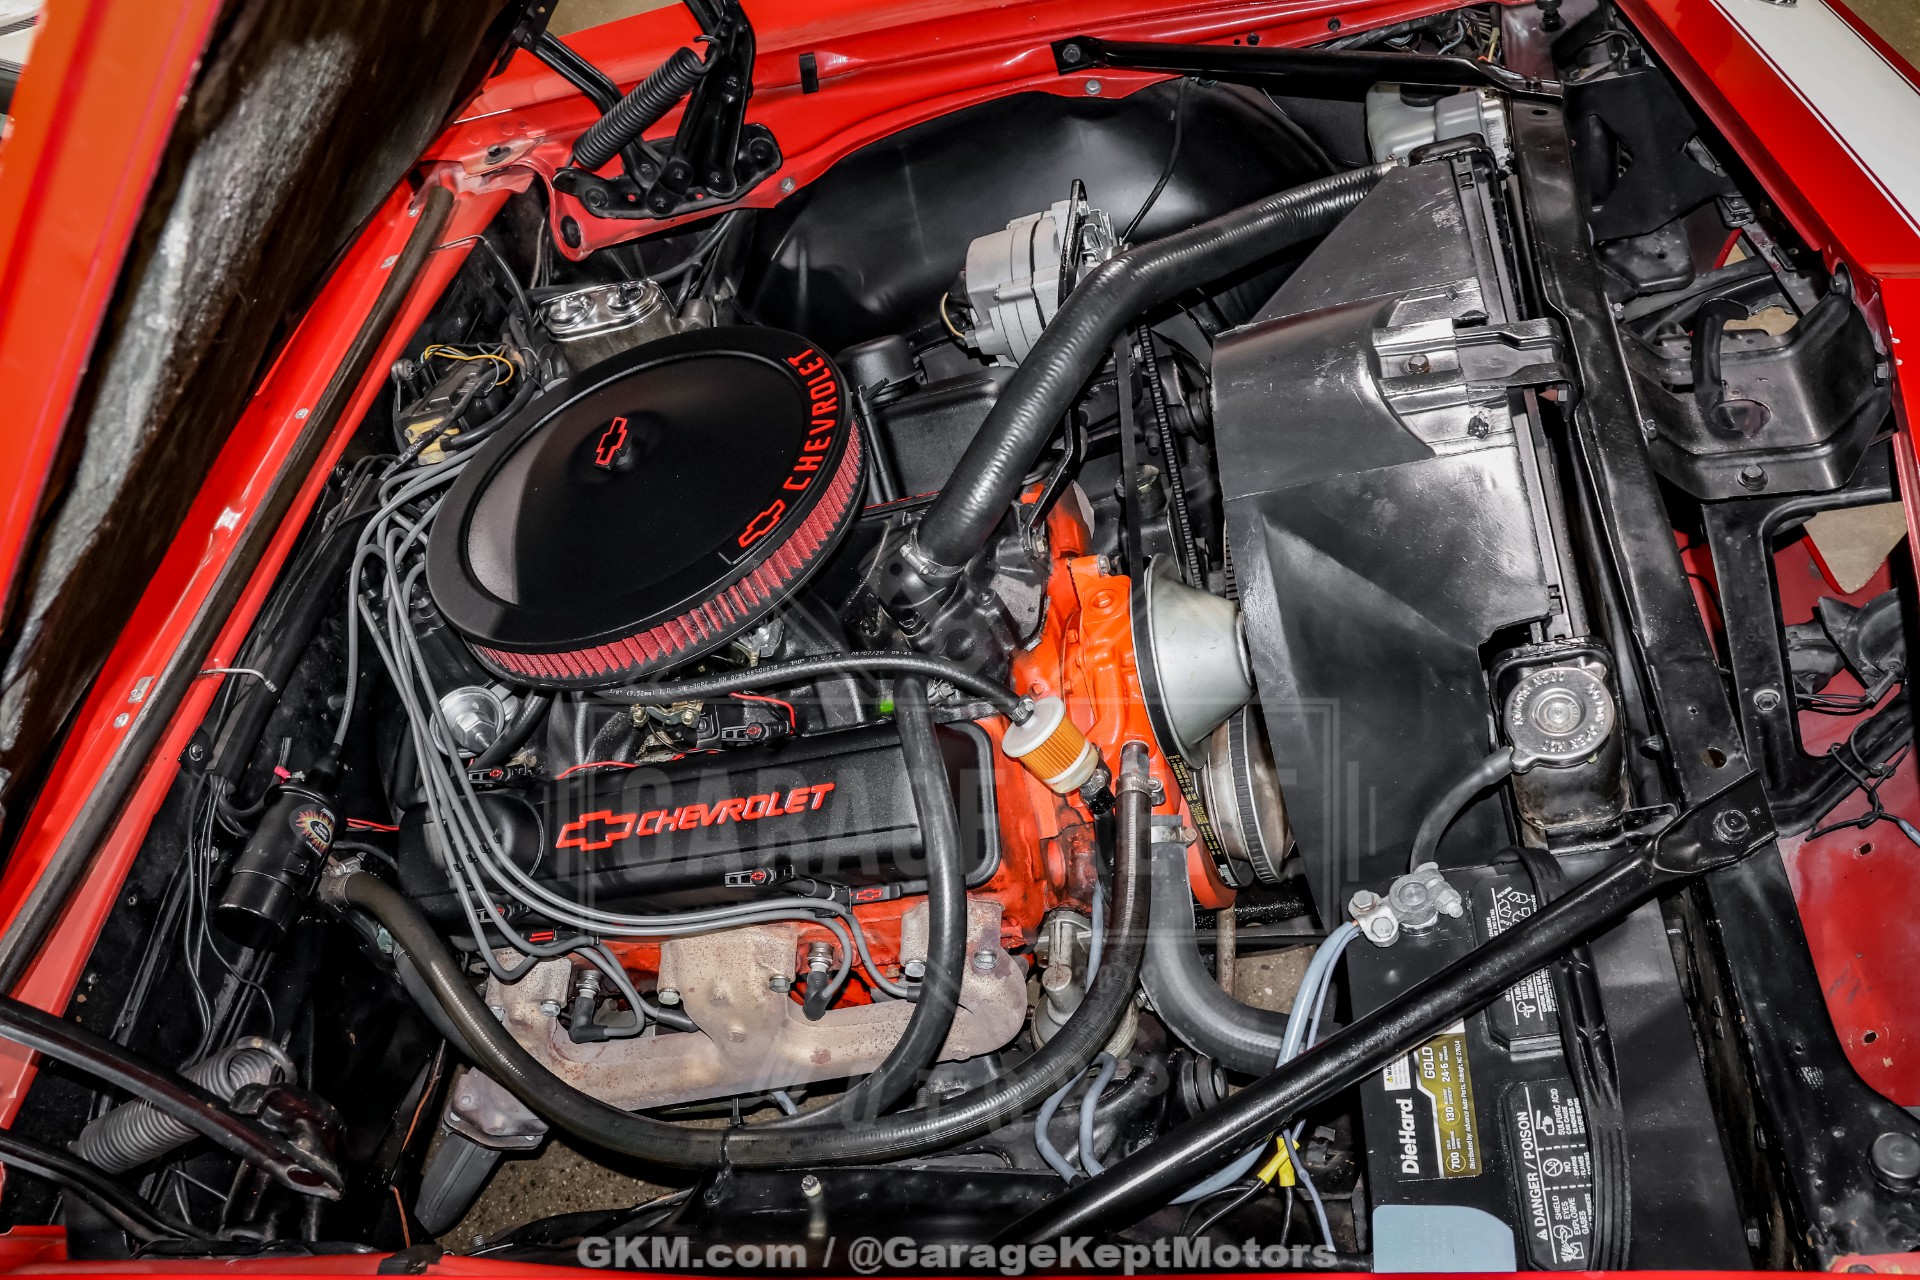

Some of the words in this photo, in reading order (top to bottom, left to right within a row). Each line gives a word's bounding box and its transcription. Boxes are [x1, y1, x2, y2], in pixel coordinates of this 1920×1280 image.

[783, 348, 838, 491] CHEVROLET
[636, 782, 835, 836] CHEVROLET
[1421, 1046, 1436, 1079] GOLD
[1461, 1098, 1469, 1111] Auto
[1550, 1088, 1560, 1103] ACID
[1445, 1106, 1455, 1122] 130
[1463, 1110, 1471, 1132] Advance
[1553, 1104, 1566, 1136] SULFURIC
[1561, 1105, 1571, 1123] CAUSE
[1396, 1098, 1420, 1175] DieHard
[1516, 1110, 1536, 1161] POISON
[1565, 1122, 1573, 1136] CAN
[1450, 1151, 1461, 1170] 700
[1466, 1140, 1477, 1170] Distributed
[1563, 1161, 1572, 1174] NO
[1527, 1172, 1547, 1228] DANGER
[1552, 1195, 1563, 1221] SHIELD
[1561, 1200, 1571, 1221] EYES
[1567, 1196, 1582, 1236] EXPLOSIVE
[1578, 1210, 1590, 1236] GASES
